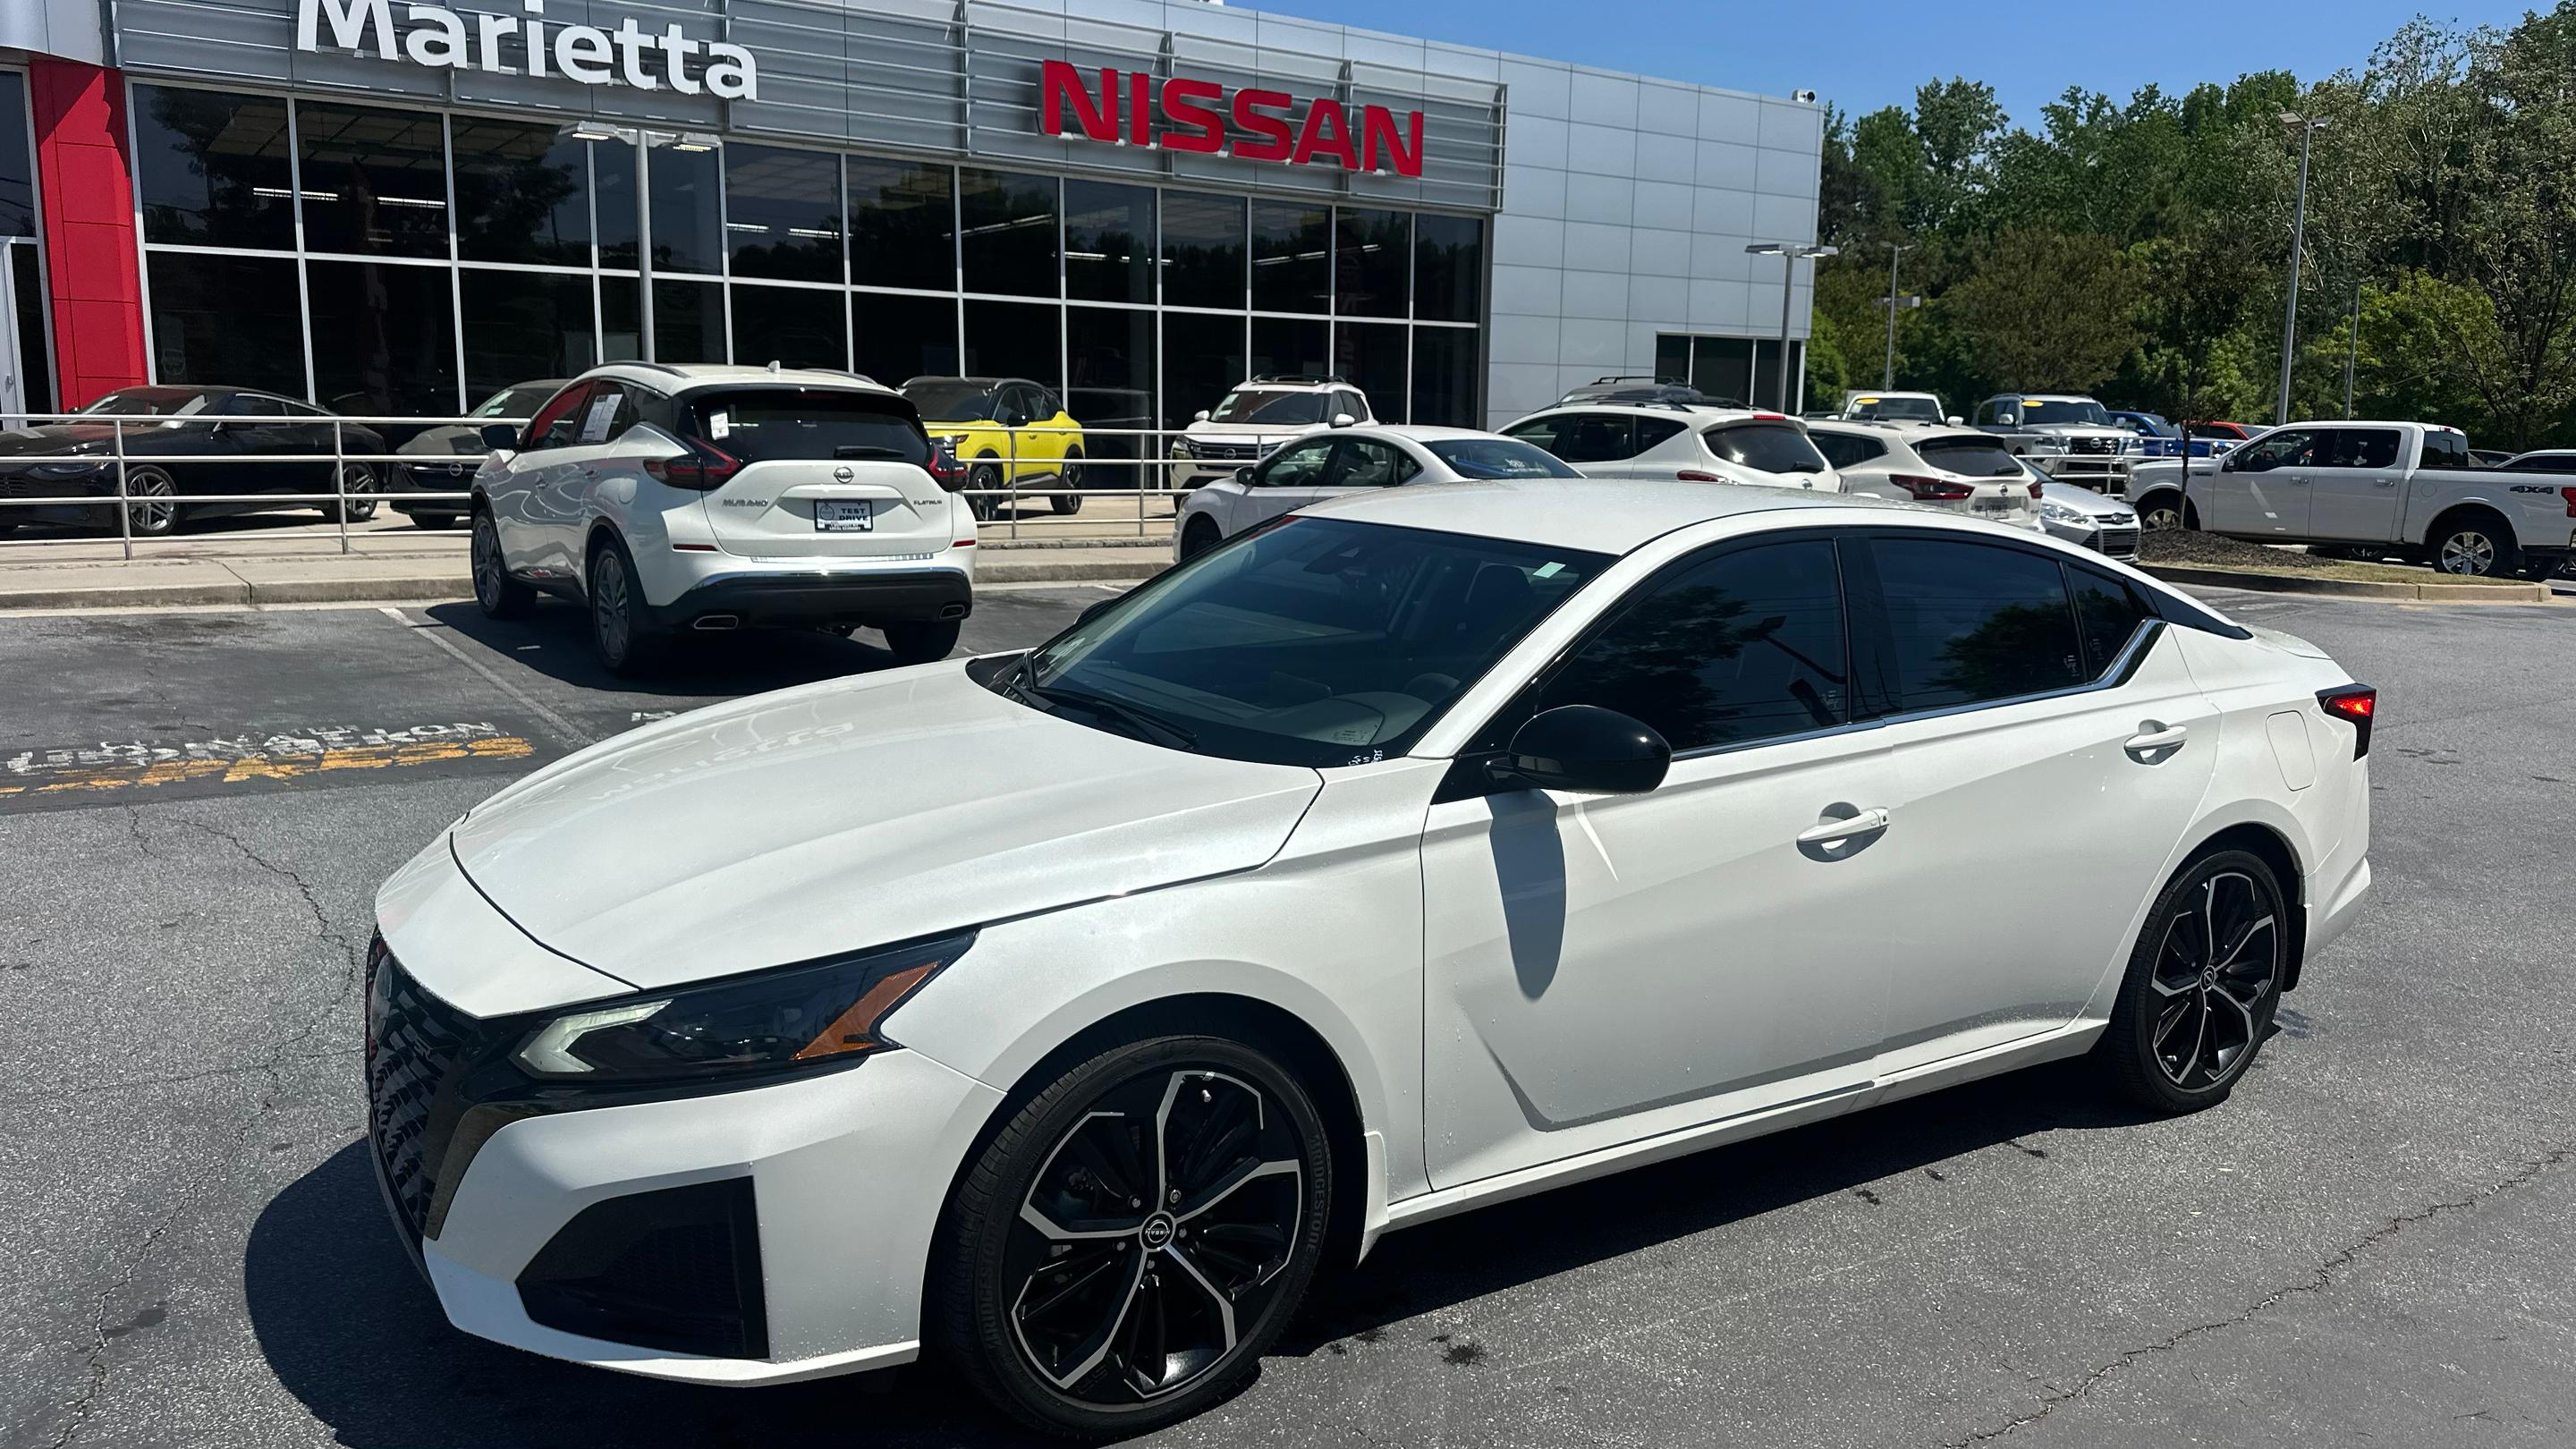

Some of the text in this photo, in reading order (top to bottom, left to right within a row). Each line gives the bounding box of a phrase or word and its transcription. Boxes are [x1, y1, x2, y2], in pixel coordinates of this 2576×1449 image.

[297, 0, 758, 100] Marietta
[1042, 59, 1424, 177] NISSAN
[1306, 1133, 1326, 1254] BRIDGESTONE
